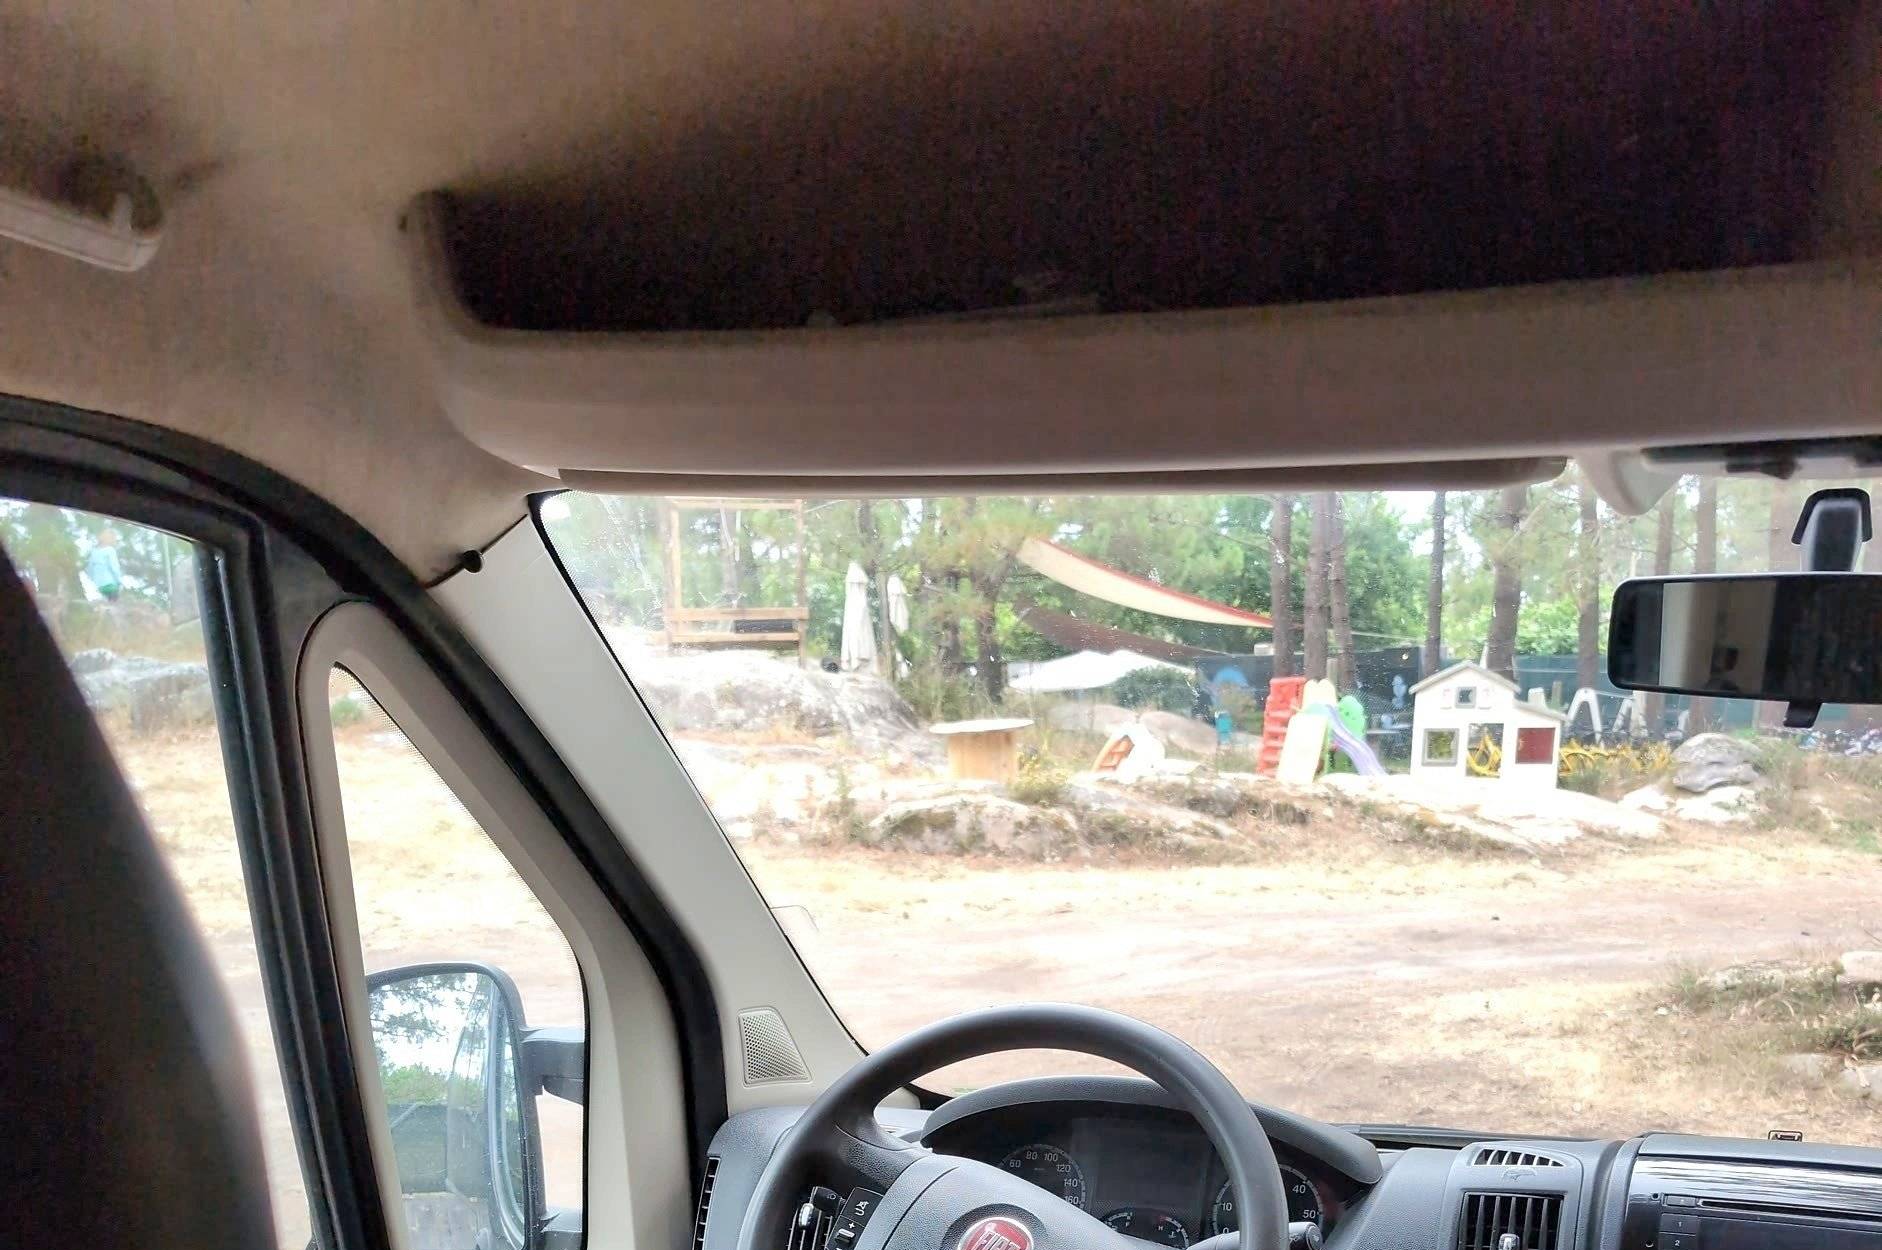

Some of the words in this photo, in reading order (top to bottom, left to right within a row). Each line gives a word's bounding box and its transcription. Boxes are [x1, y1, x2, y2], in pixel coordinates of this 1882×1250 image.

[1026, 1151, 1038, 1160] 80
[1044, 1153, 1059, 1162] 100
[1009, 1160, 1021, 1168] 60
[1063, 1178, 1078, 1188] 140
[1292, 1184, 1306, 1194] 40
[1222, 1202, 1233, 1212] 10
[1303, 1209, 1316, 1219] 50
